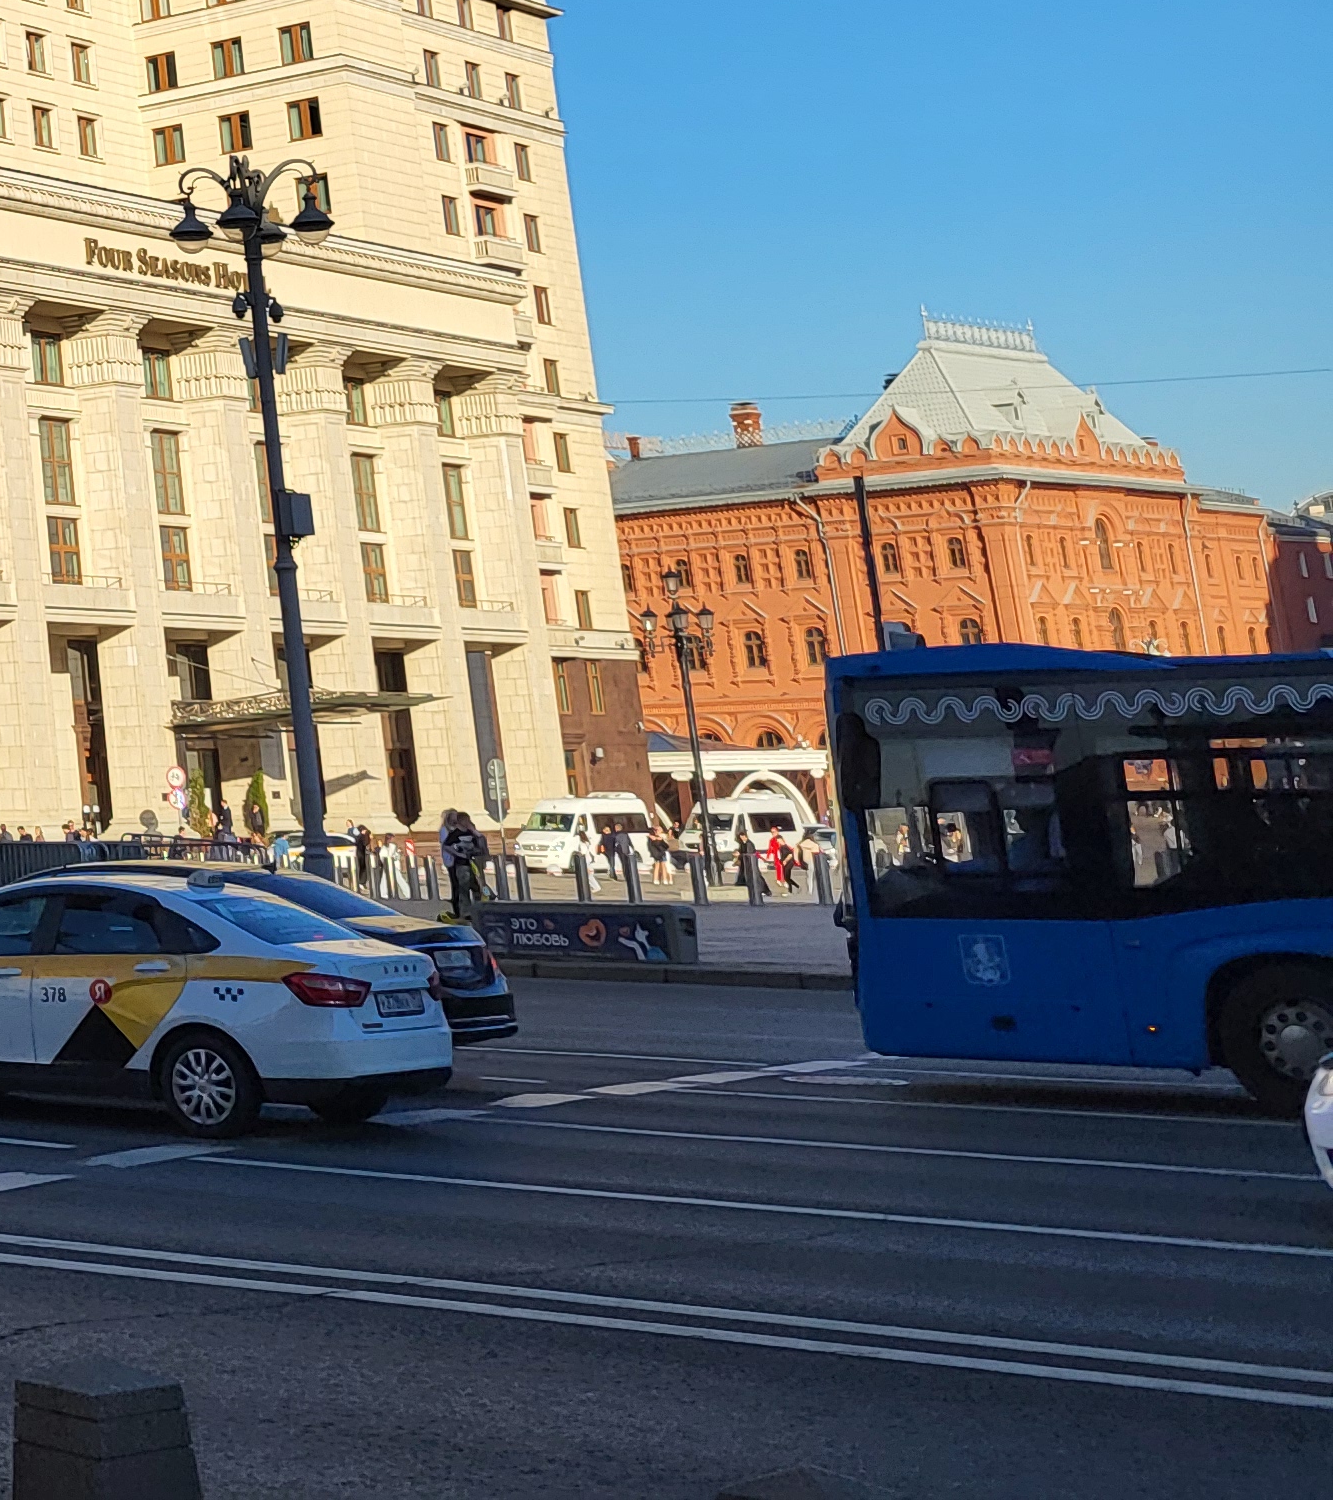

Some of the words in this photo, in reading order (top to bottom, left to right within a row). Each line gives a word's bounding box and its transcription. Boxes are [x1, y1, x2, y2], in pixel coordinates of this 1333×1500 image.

[510, 918, 537, 930] ЭТО
[513, 932, 569, 947] ЛЮБОВЬ
[40, 986, 67, 1003] 378
[94, 983, 105, 1000] Я
